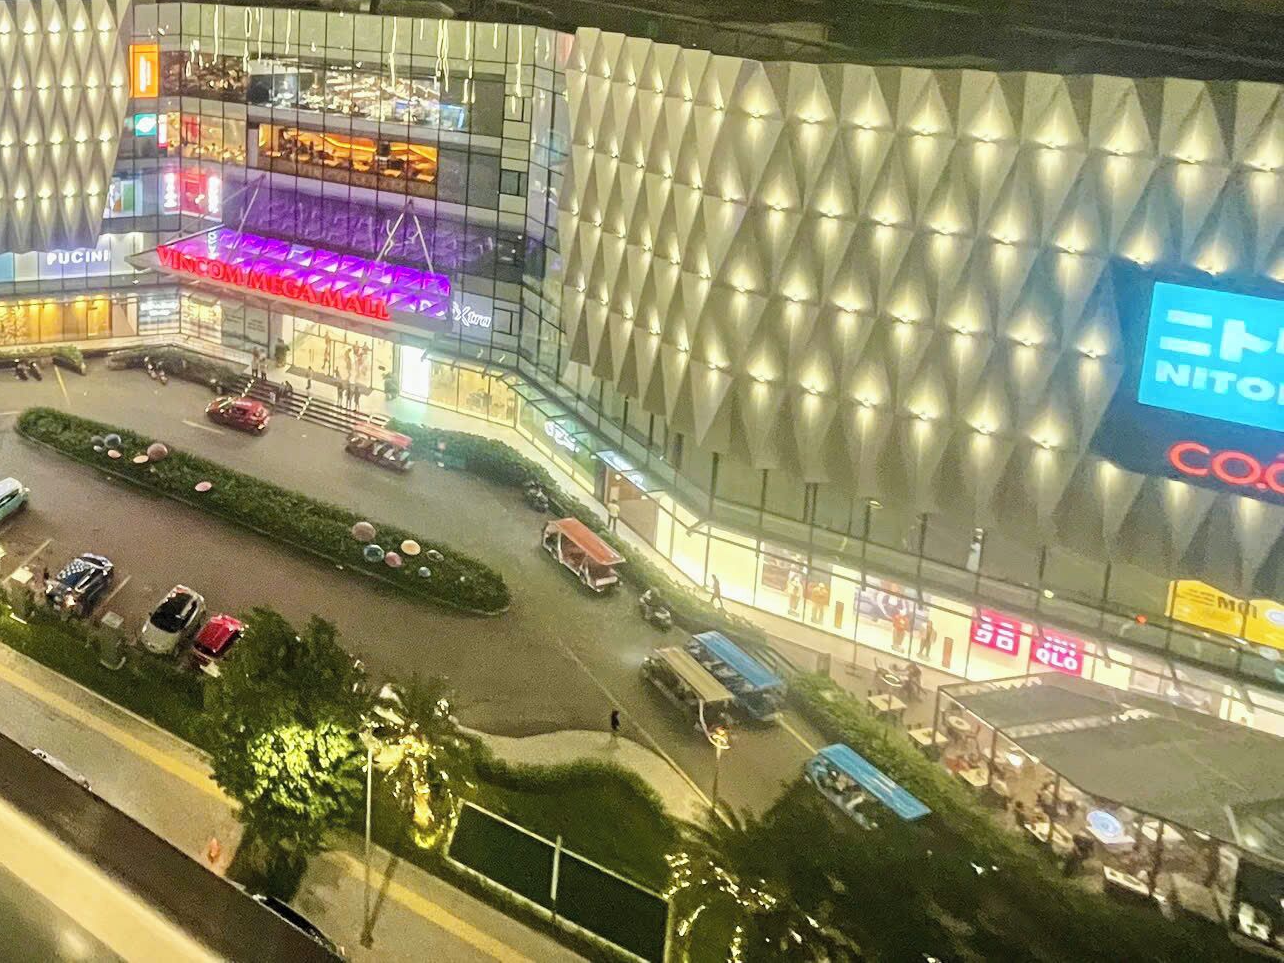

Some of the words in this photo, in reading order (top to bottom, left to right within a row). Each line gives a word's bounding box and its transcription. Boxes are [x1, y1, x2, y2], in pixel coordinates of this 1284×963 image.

[46, 249, 111, 266] PUCINI
[156, 245, 245, 286] VINCOM
[249, 270, 316, 304] MEGA
[322, 288, 390, 320] MALL
[1160, 309, 1284, 363] ニト
[1155, 360, 1284, 406] NITO
[1036, 648, 1078, 671] QLO
